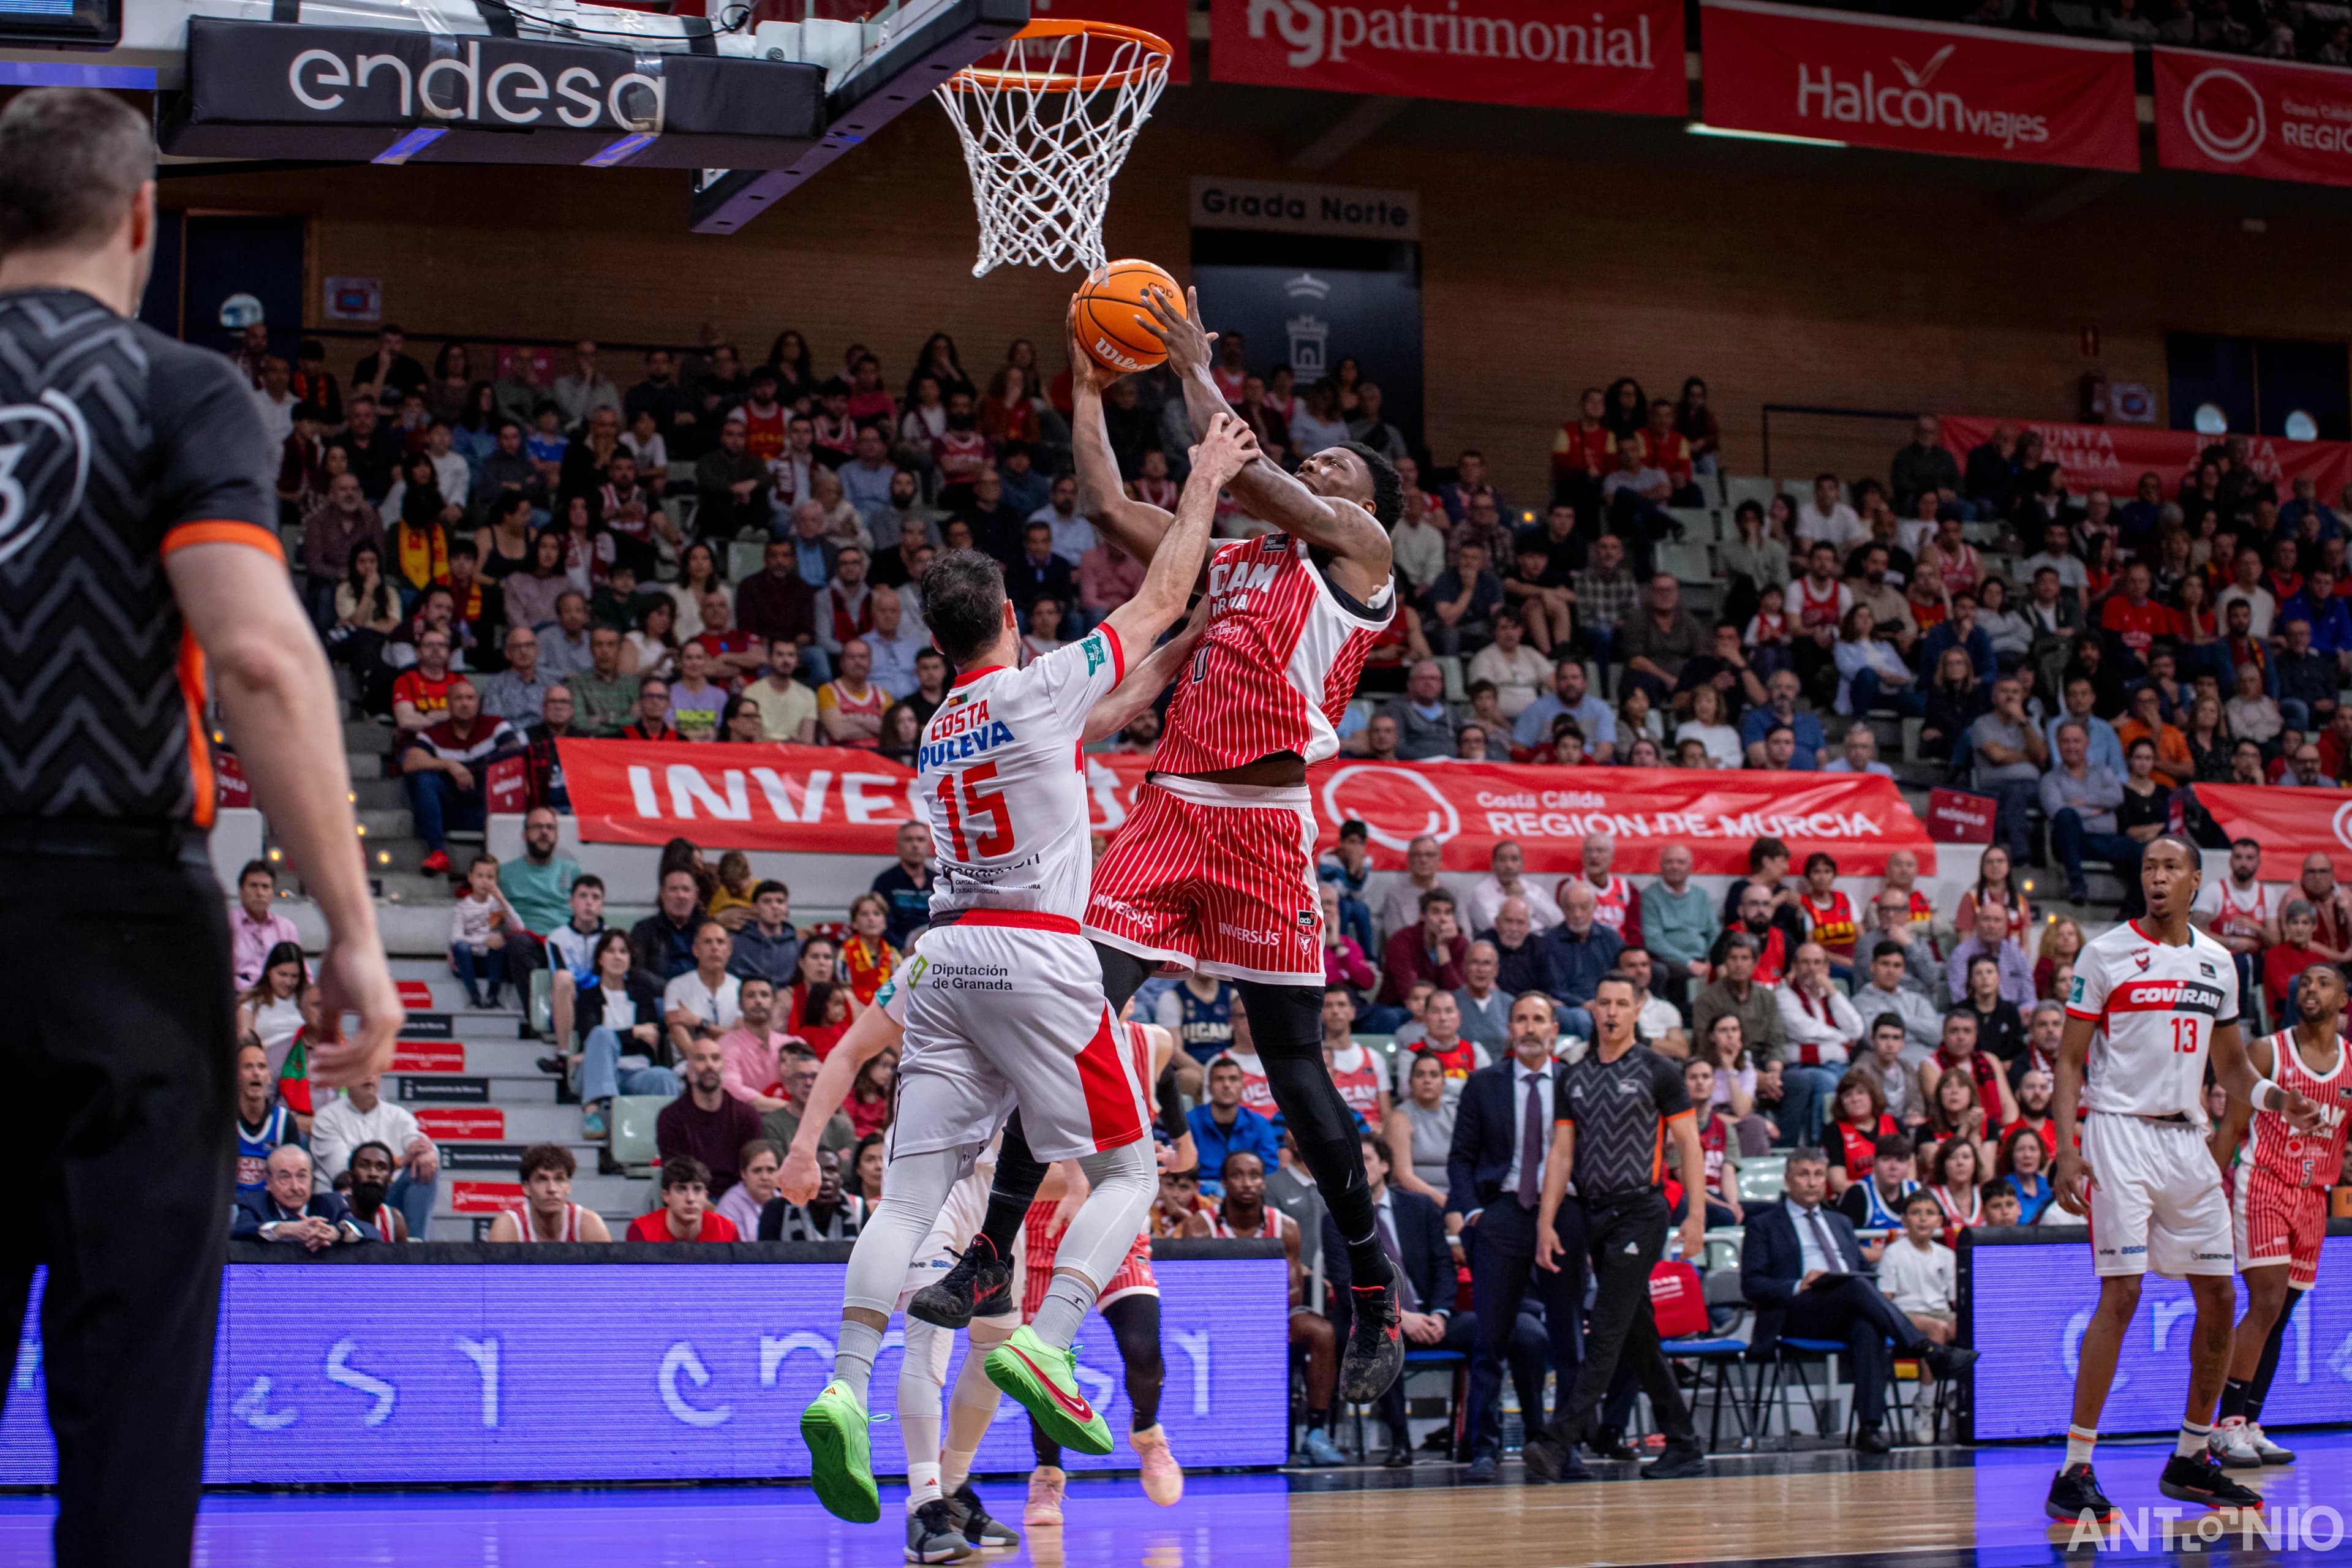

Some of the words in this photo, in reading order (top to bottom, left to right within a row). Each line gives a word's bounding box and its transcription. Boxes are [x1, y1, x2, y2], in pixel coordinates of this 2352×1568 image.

[1328, 0, 1654, 70] patrimonial
[288, 41, 666, 131] endesa
[1202, 189, 1305, 219] Grada
[1321, 196, 1407, 226] Norte
[931, 699, 990, 742] COSTA
[919, 720, 1016, 774] PULEVA
[937, 761, 1016, 862] 15
[1477, 791, 1537, 809] Costa
[1542, 790, 1606, 809] Cálida
[1487, 810, 1652, 837] REGIÓN
[1655, 812, 1715, 837] DE
[1717, 812, 1883, 838] MURCIA
[1092, 893, 1156, 929] INVERSUS
[1218, 921, 1281, 946] INVERSUS
[932, 963, 1008, 977] Diputación
[932, 978, 949, 989] de
[952, 978, 1012, 990] Granada
[2170, 1017, 2197, 1053] 13
[2301, 1159, 2314, 1188] 5
